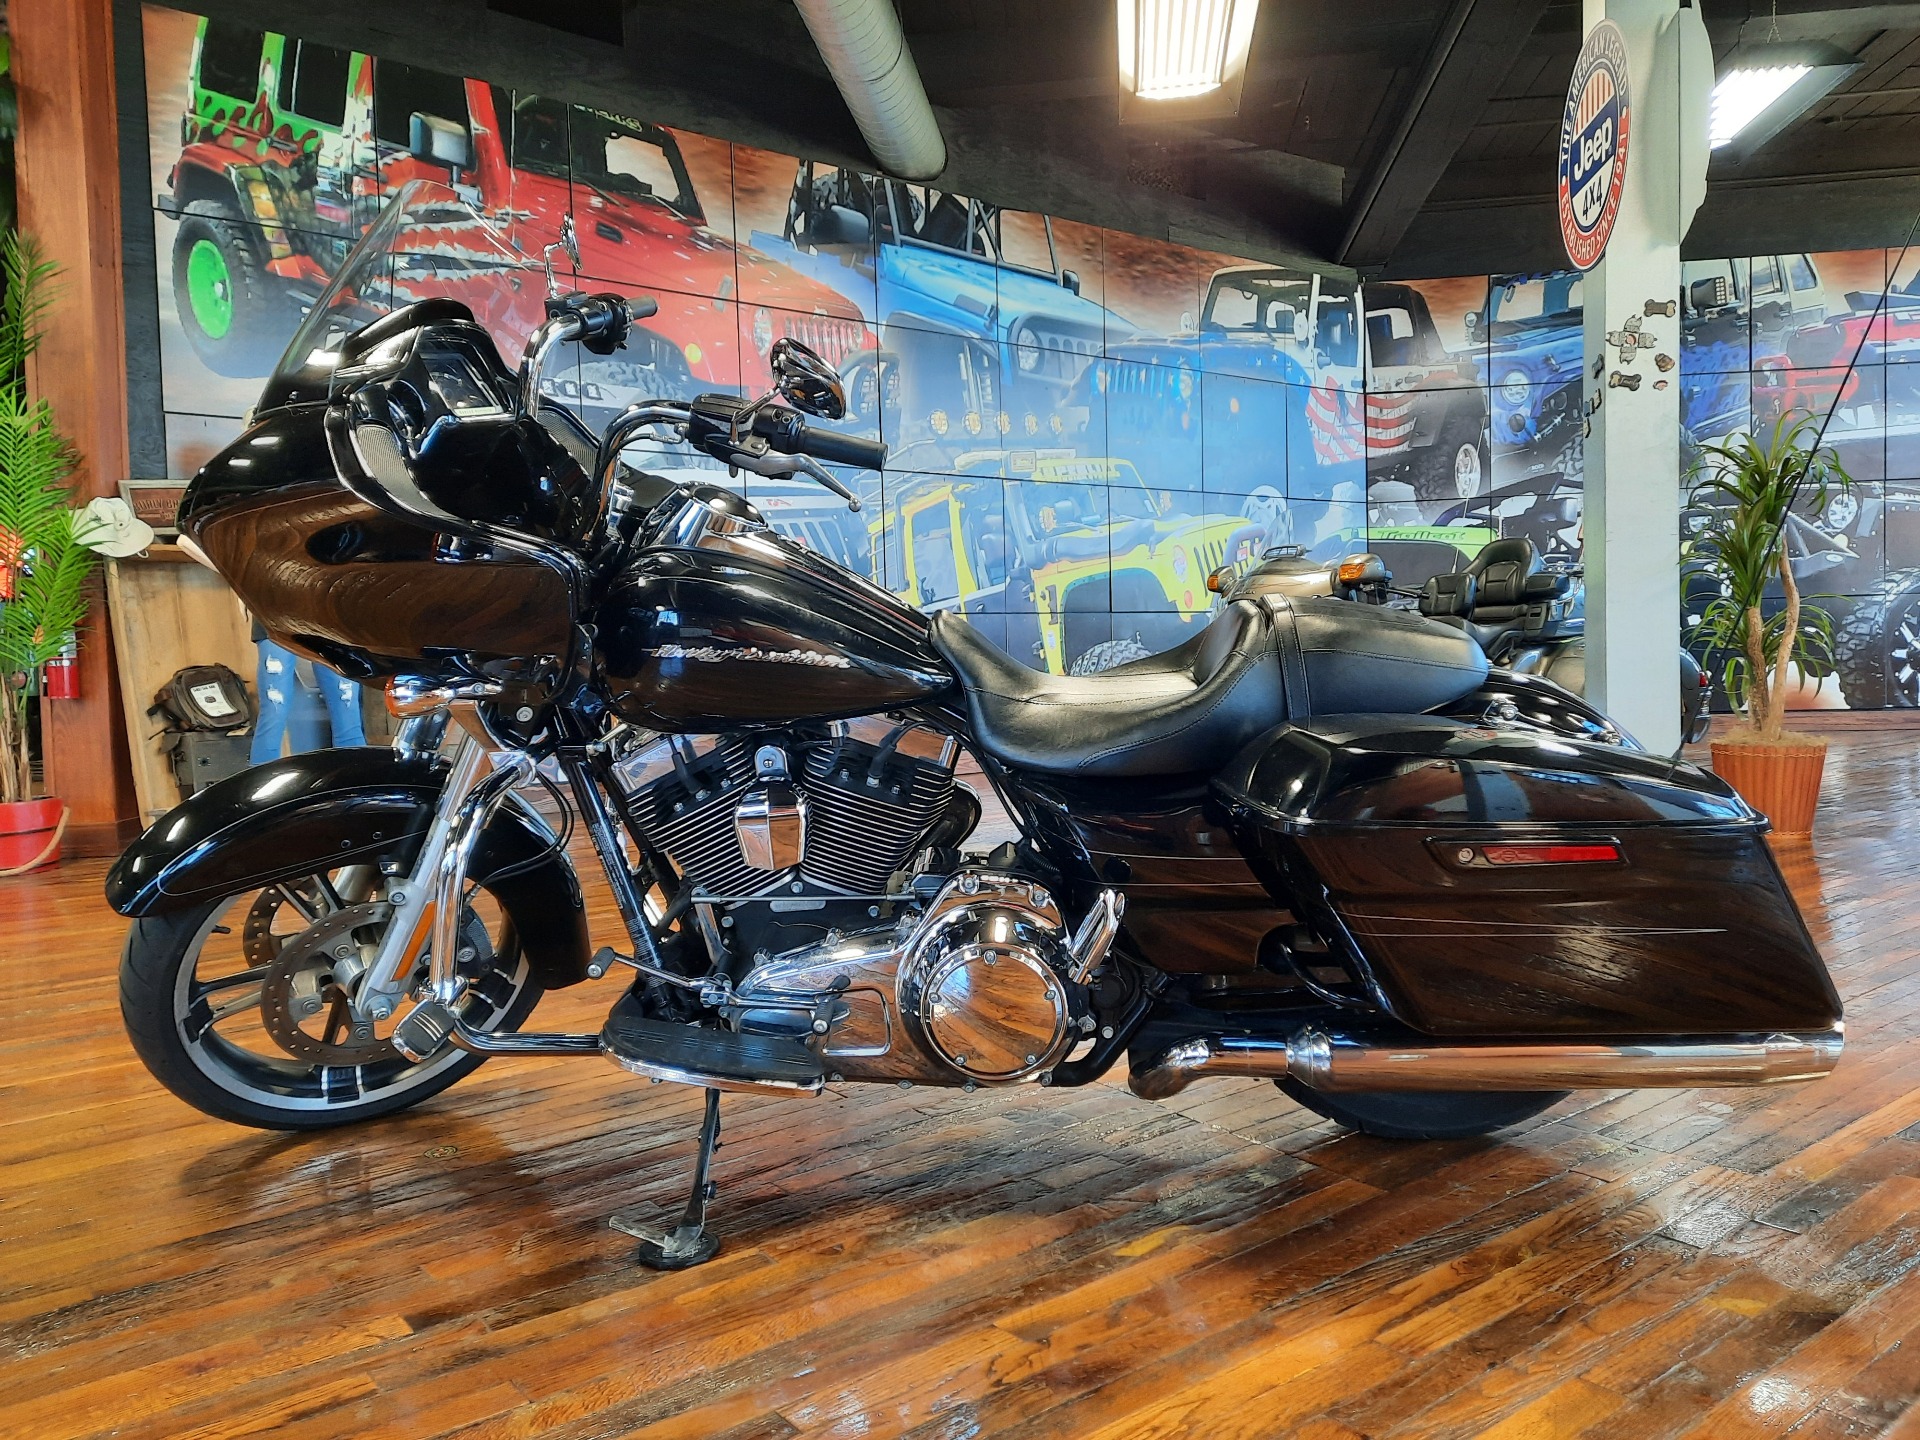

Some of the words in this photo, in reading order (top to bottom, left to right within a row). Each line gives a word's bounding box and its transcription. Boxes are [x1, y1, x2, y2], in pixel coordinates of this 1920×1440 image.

[1561, 120, 1572, 163] THE
[1569, 32, 1605, 115] AMERICAN
[1605, 33, 1627, 96] LEGEND
[1574, 117, 1612, 181] Jeep
[1561, 192, 1596, 261] ESTABLISHED
[1597, 191, 1616, 250] SINCE
[1613, 133, 1627, 187] 1941
